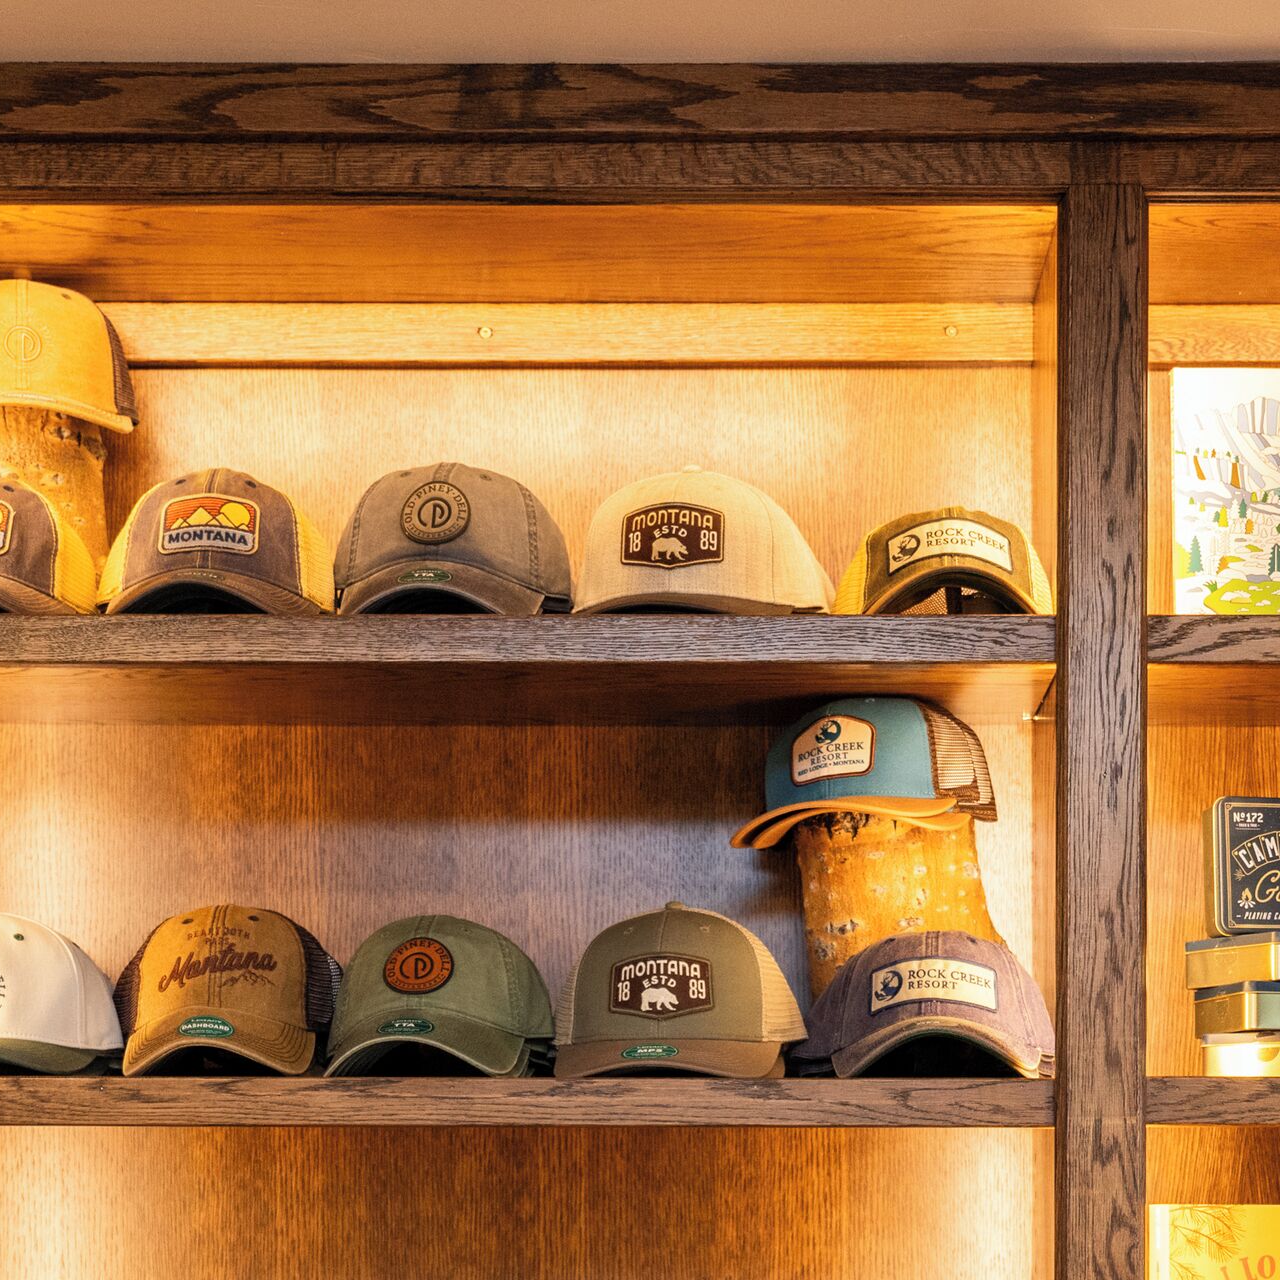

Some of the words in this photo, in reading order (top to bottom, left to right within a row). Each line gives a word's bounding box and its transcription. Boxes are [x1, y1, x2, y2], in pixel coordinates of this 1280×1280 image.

[404, 501, 416, 524] OLD
[415, 484, 454, 500] PINEY
[452, 493, 467, 522] DELL
[631, 509, 713, 531] MONTANA
[168, 530, 249, 546] MONTANA
[653, 525, 688, 538] ESTD
[700, 530, 718, 551] 89
[926, 527, 964, 540] ROCK
[968, 530, 1006, 553] CREEK
[628, 531, 642, 553] 18
[926, 538, 976, 548] RESORT
[798, 746, 823, 762] ROCK
[826, 742, 865, 752] CREEK
[810, 752, 848, 765] RESORT
[1244, 912, 1272, 920] PLAYING
[398, 940, 434, 955] PINEY
[158, 943, 278, 993] Montana
[621, 959, 701, 981] MONTANA
[642, 975, 677, 988] ESTD
[907, 968, 946, 980] ROCK
[950, 970, 993, 989] CREEK
[907, 980, 958, 990] RESORT
[617, 981, 630, 1002] 18
[688, 979, 706, 999] 89
[182, 1023, 230, 1031] DASHBOARD
